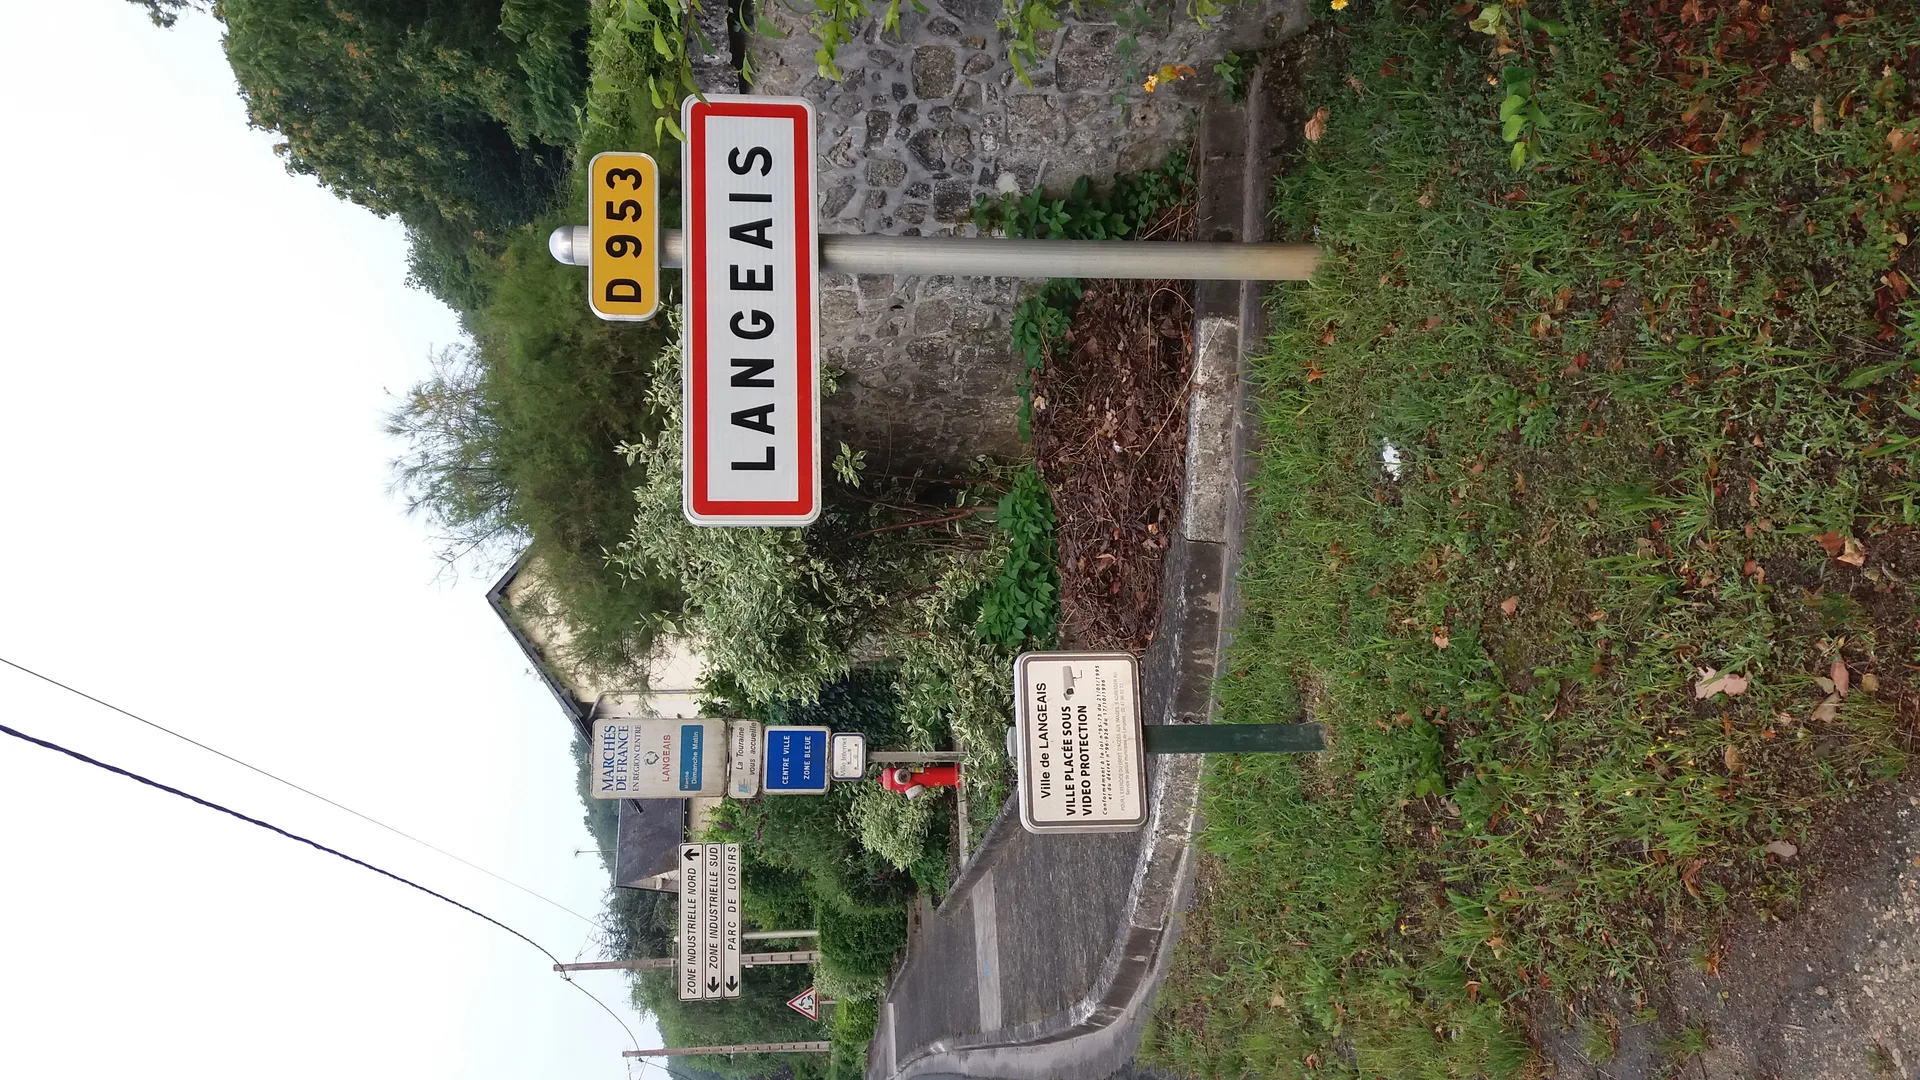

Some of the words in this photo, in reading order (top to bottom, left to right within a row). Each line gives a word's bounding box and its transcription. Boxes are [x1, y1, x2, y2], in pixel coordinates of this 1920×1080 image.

[605, 167, 642, 258] 953
[605, 278, 642, 303] D
[727, 145, 776, 471] LANGEAIS
[1036, 683, 1049, 748] LANGEAIS
[1062, 706, 1072, 736] SOUS
[616, 725, 628, 772] FRANCE
[736, 727, 745, 757] Touraine
[1077, 705, 1090, 776] PROTECTION
[600, 725, 616, 791] MARCHÉS
[632, 754, 640, 780] RÉGION
[662, 735, 670, 782] LANGEAIS
[736, 761, 743, 770] La
[1040, 753, 1050, 768] de
[1061, 740, 1074, 781] PLACÉE
[616, 776, 626, 791] DE
[632, 782, 639, 792] EN
[1040, 772, 1050, 798] Ville
[1081, 780, 1092, 816] VIDEO
[1065, 785, 1076, 816] VILLE
[709, 847, 718, 867] SUD
[728, 846, 736, 890] LOISIRS
[688, 868, 696, 895] NORD
[709, 871, 718, 939] INDUSTRIELLE
[728, 899, 736, 913] DE
[687, 899, 696, 965] INDUSTRIELLE
[728, 921, 736, 950] PARC
[709, 943, 718, 969] ZONE
[687, 968, 696, 994] ZONE
